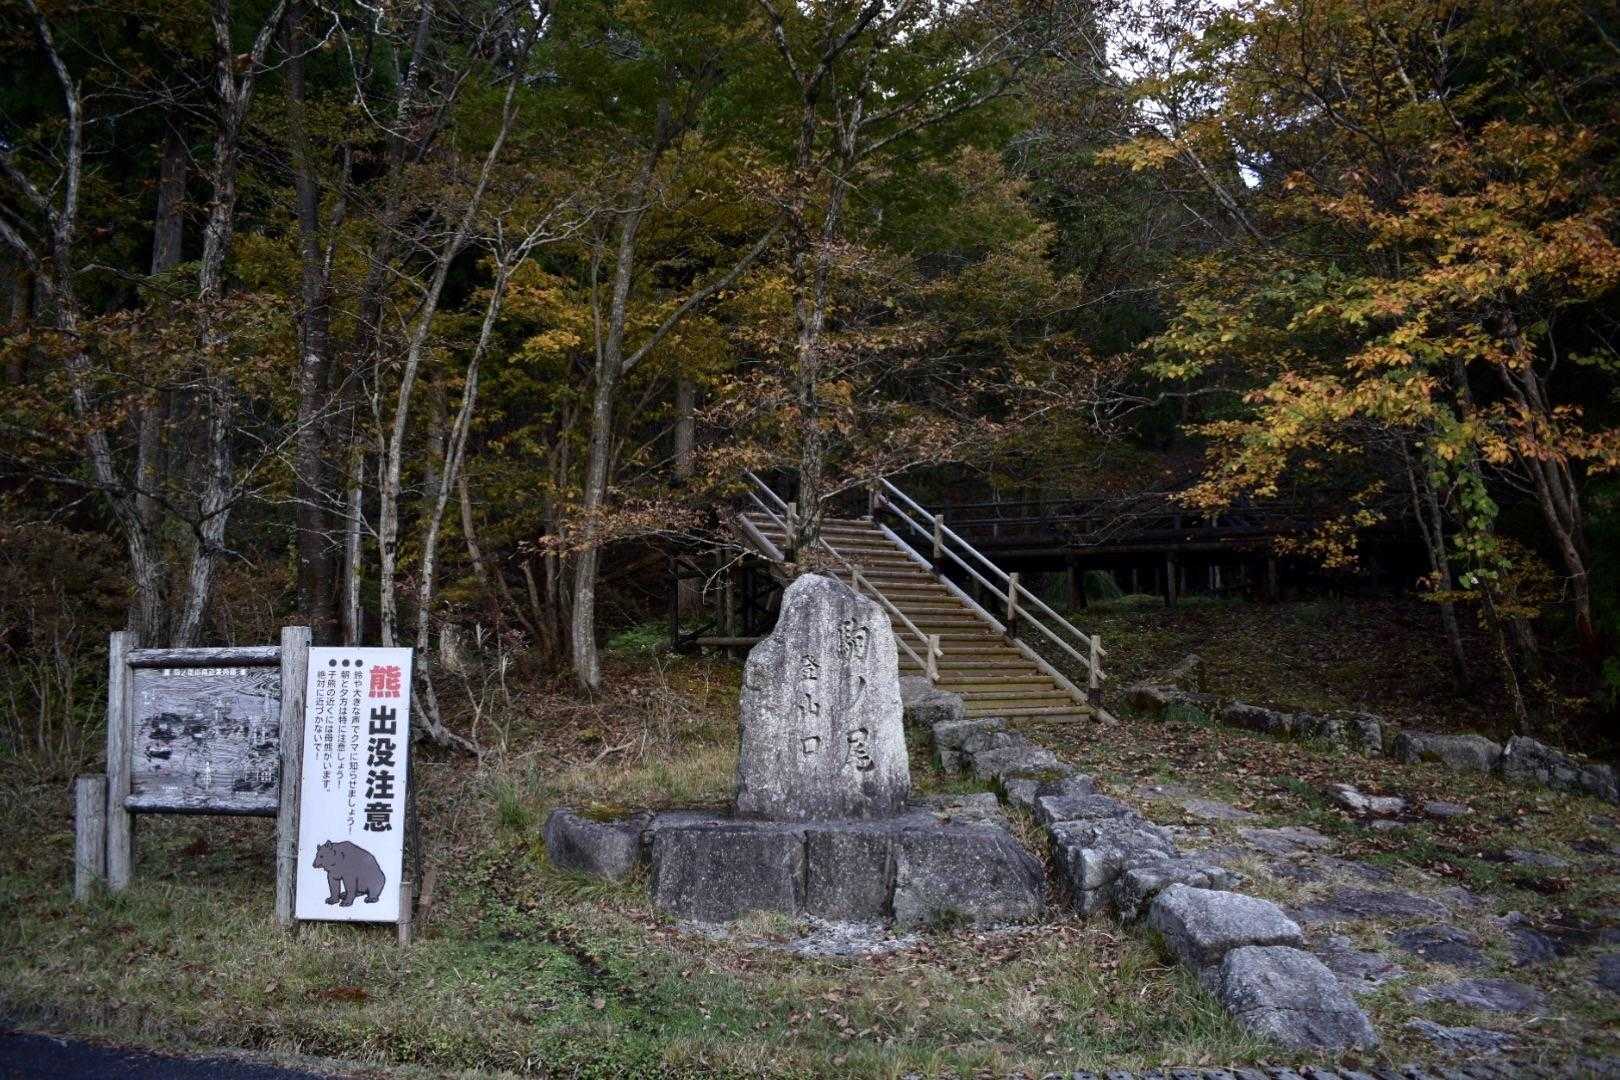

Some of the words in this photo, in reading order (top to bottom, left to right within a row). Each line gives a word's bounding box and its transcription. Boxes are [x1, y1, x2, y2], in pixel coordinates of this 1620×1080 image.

[363, 664, 401, 832] 熊出没注意
